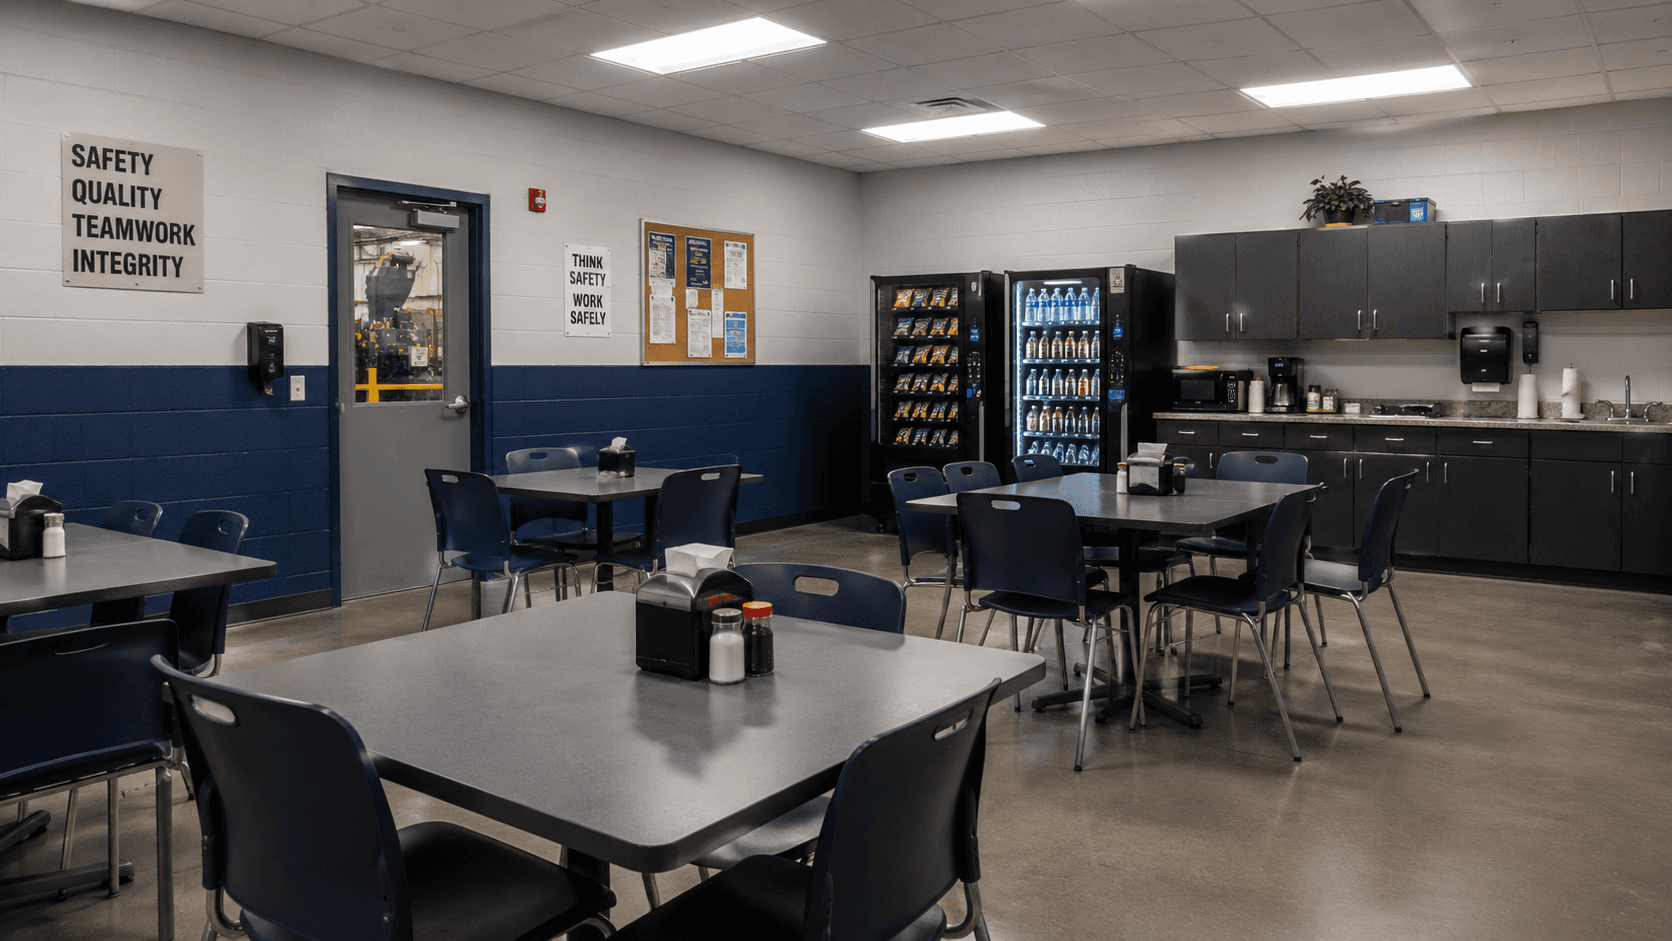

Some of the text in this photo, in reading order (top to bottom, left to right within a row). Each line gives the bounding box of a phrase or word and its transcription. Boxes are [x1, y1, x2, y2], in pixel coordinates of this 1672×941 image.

[71, 143, 154, 176] SAFETY
[72, 178, 163, 210] QUALITY
[72, 213, 196, 246] TEAMWORK
[73, 248, 184, 278] INTEGRITY
[572, 253, 603, 270] THINK
[569, 270, 606, 287] SAFETY
[573, 293, 603, 309] WORK
[570, 310, 606, 326] SAFELY
